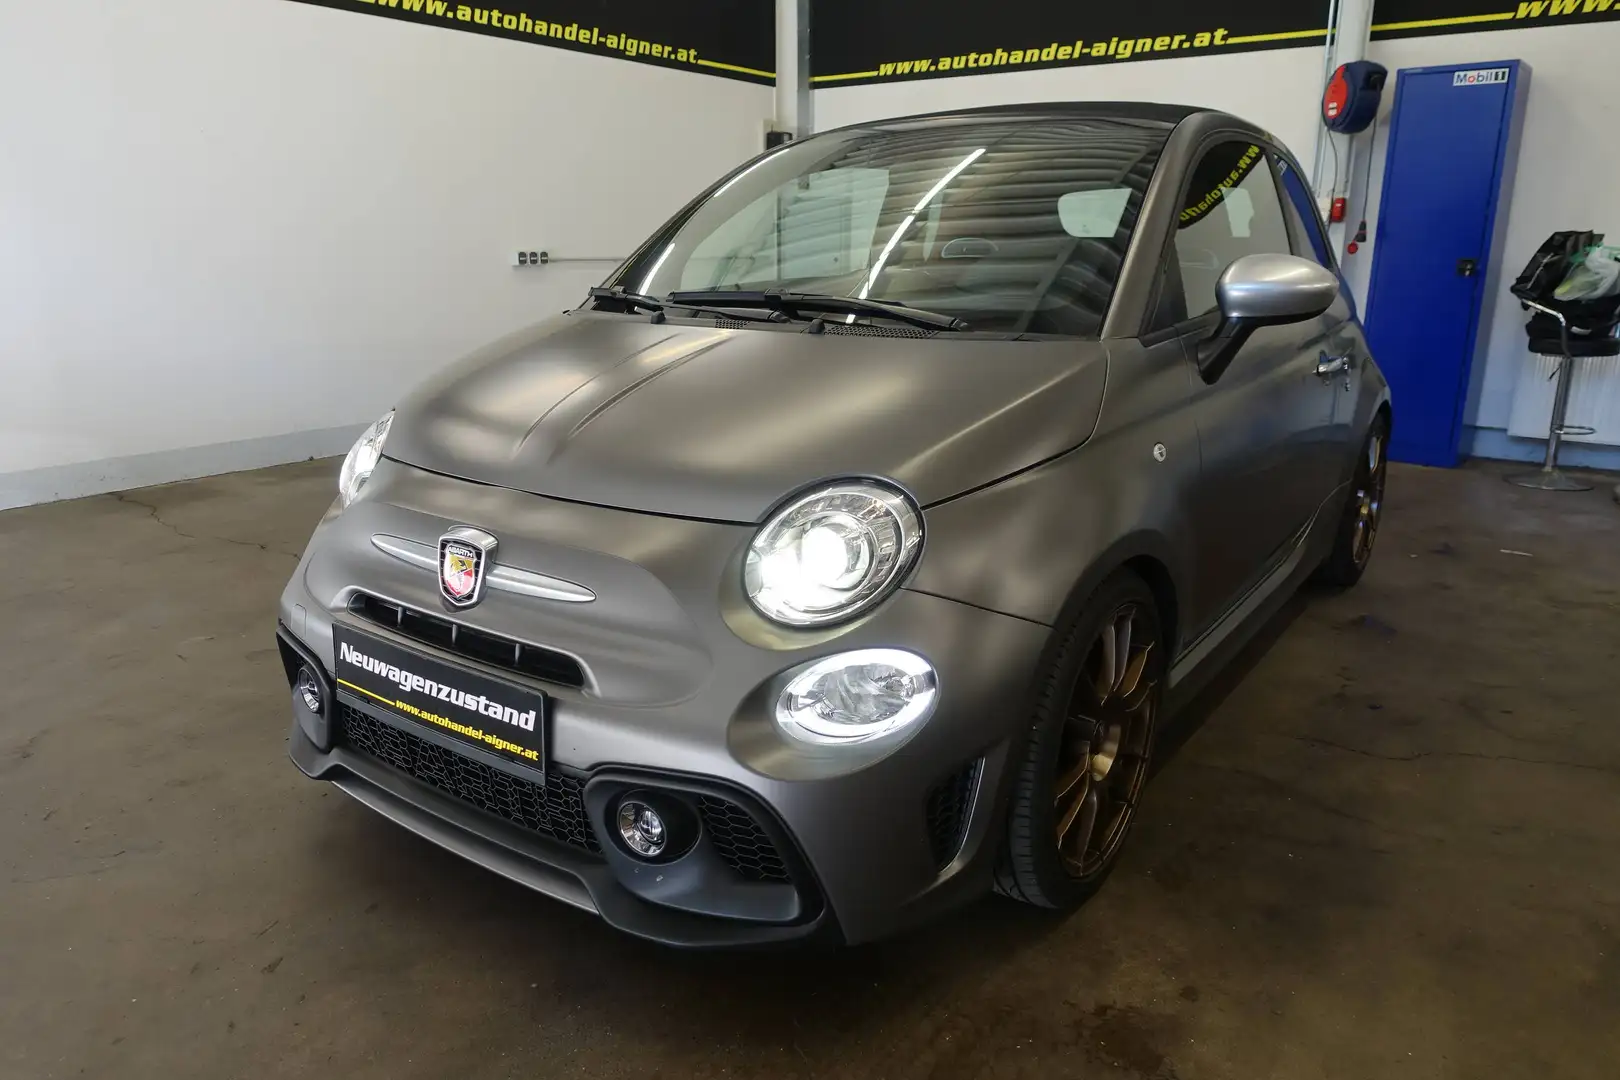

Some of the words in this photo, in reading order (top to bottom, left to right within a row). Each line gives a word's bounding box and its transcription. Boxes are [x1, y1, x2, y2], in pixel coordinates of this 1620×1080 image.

[878, 27, 1229, 77] www.autohandel-aigner.at
[448, 546, 473, 558] ABARTH
[340, 641, 536, 732] Neuwagenzustand
[395, 699, 539, 761] www.autohandel-aigner.at
